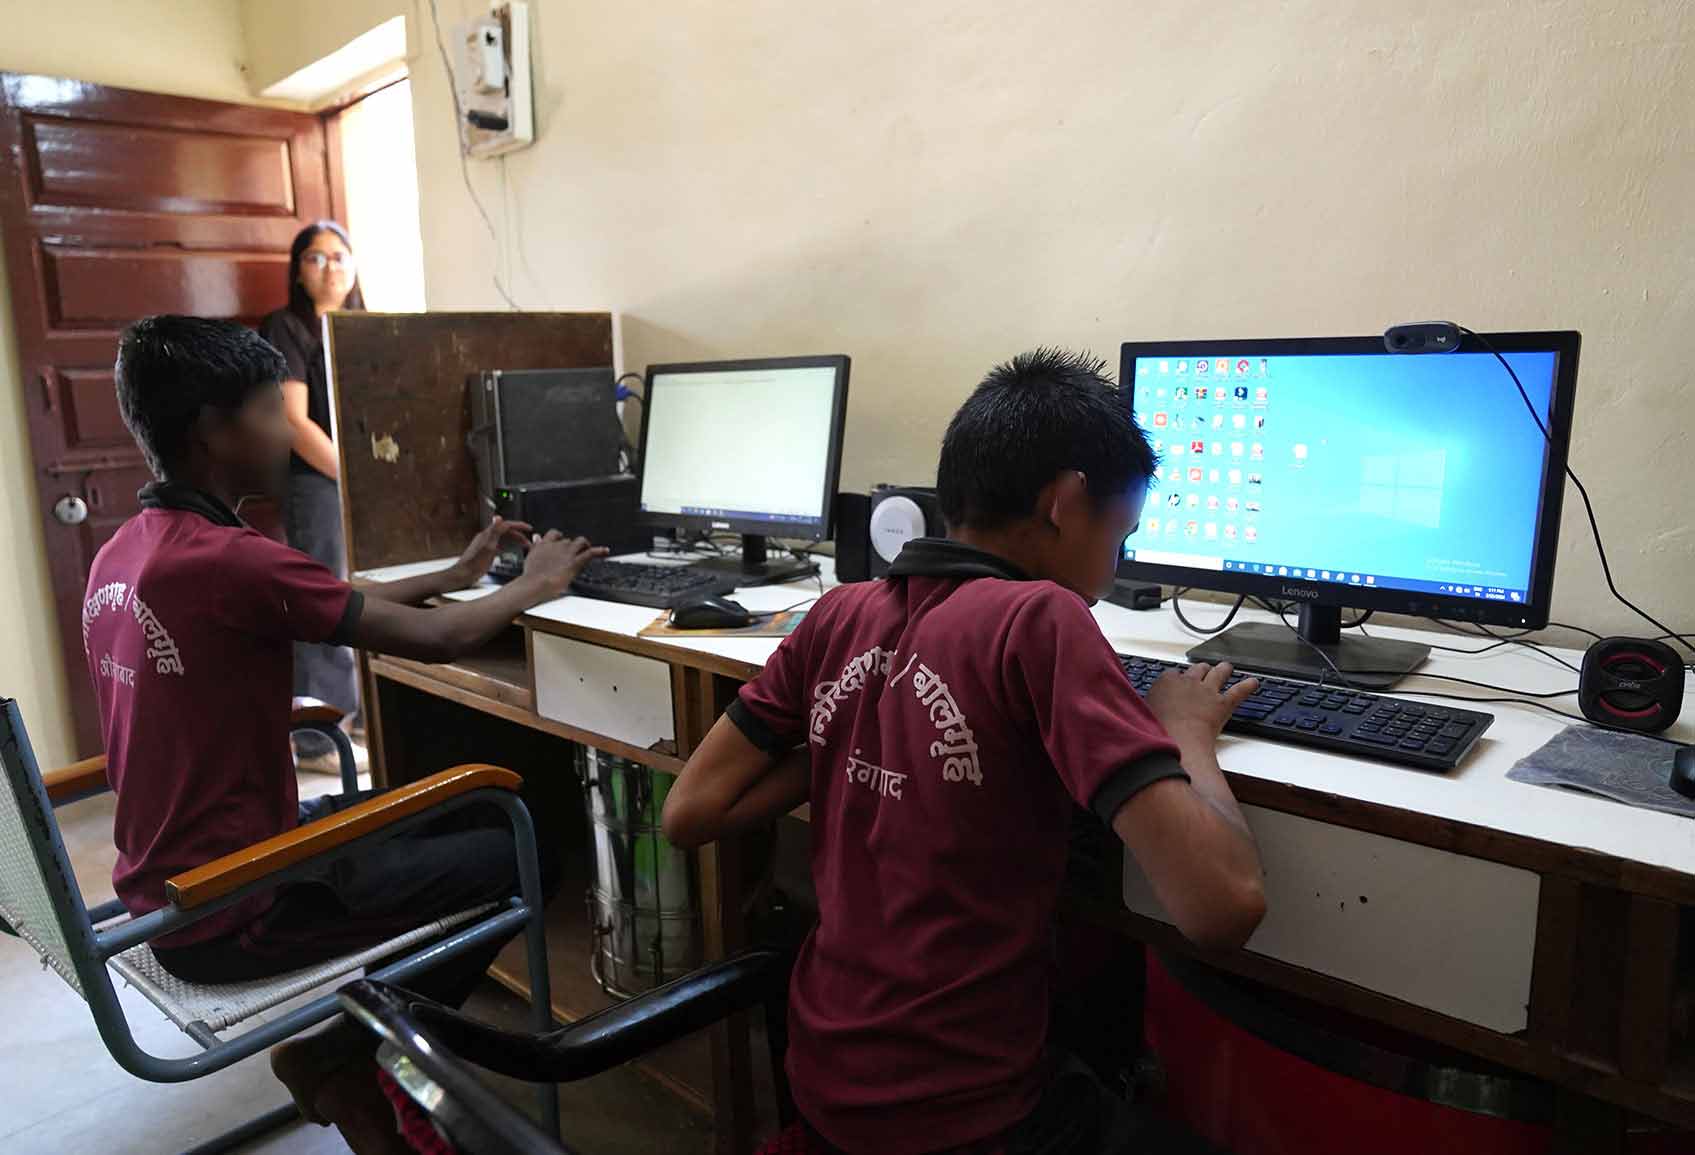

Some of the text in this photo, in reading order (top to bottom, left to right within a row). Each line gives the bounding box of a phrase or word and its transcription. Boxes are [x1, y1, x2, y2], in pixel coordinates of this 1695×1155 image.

[1281, 584, 1319, 599] Lenovo
[132, 594, 184, 675] बालगृह
[913, 663, 983, 786] बालगृह
